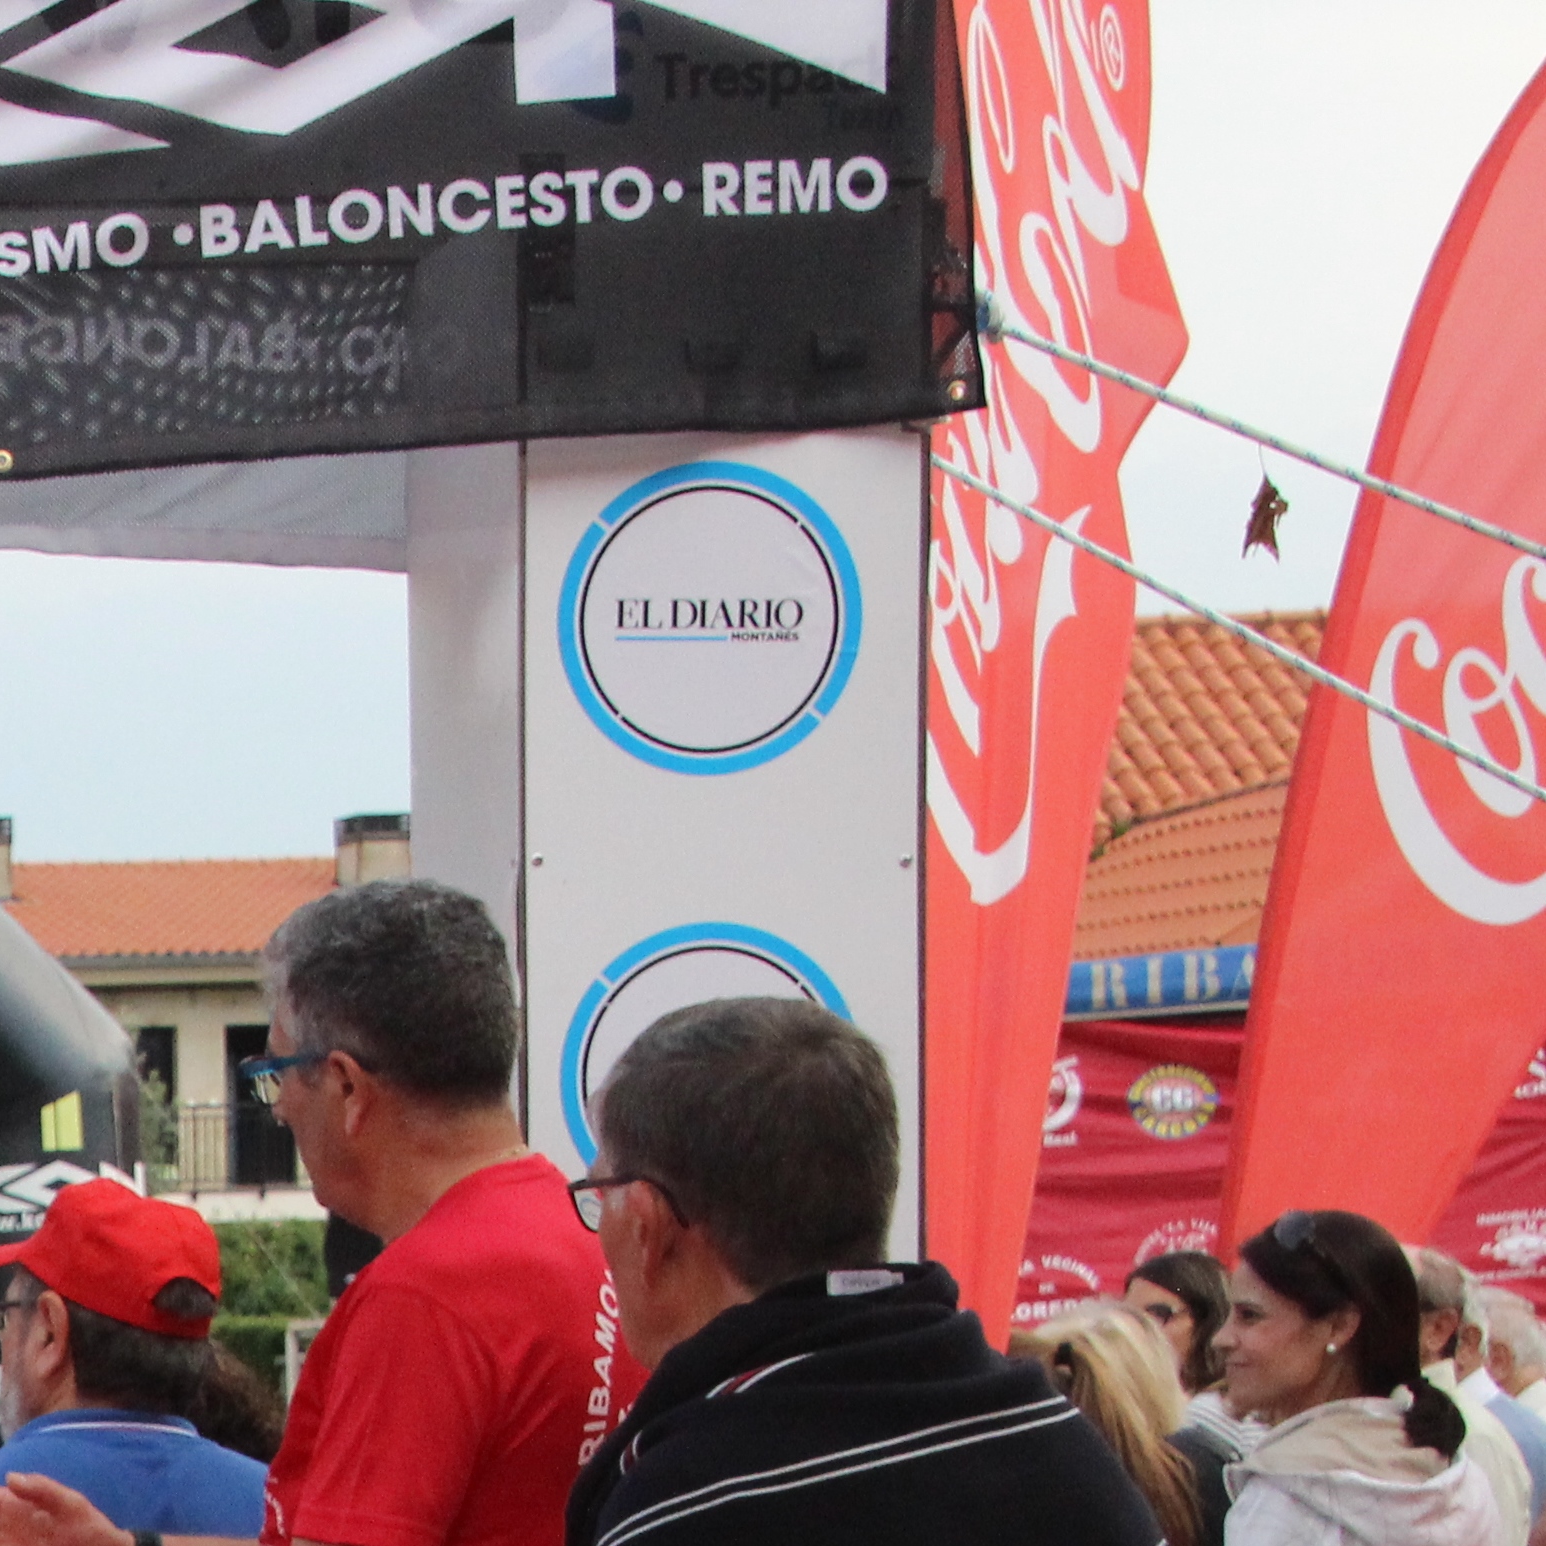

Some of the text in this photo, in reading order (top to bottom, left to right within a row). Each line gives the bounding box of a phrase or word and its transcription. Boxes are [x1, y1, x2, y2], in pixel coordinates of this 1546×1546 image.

[199, 165, 654, 259] BALONCESTO
[702, 156, 888, 217] REMO
[614, 599, 804, 629] EL DIARIO
